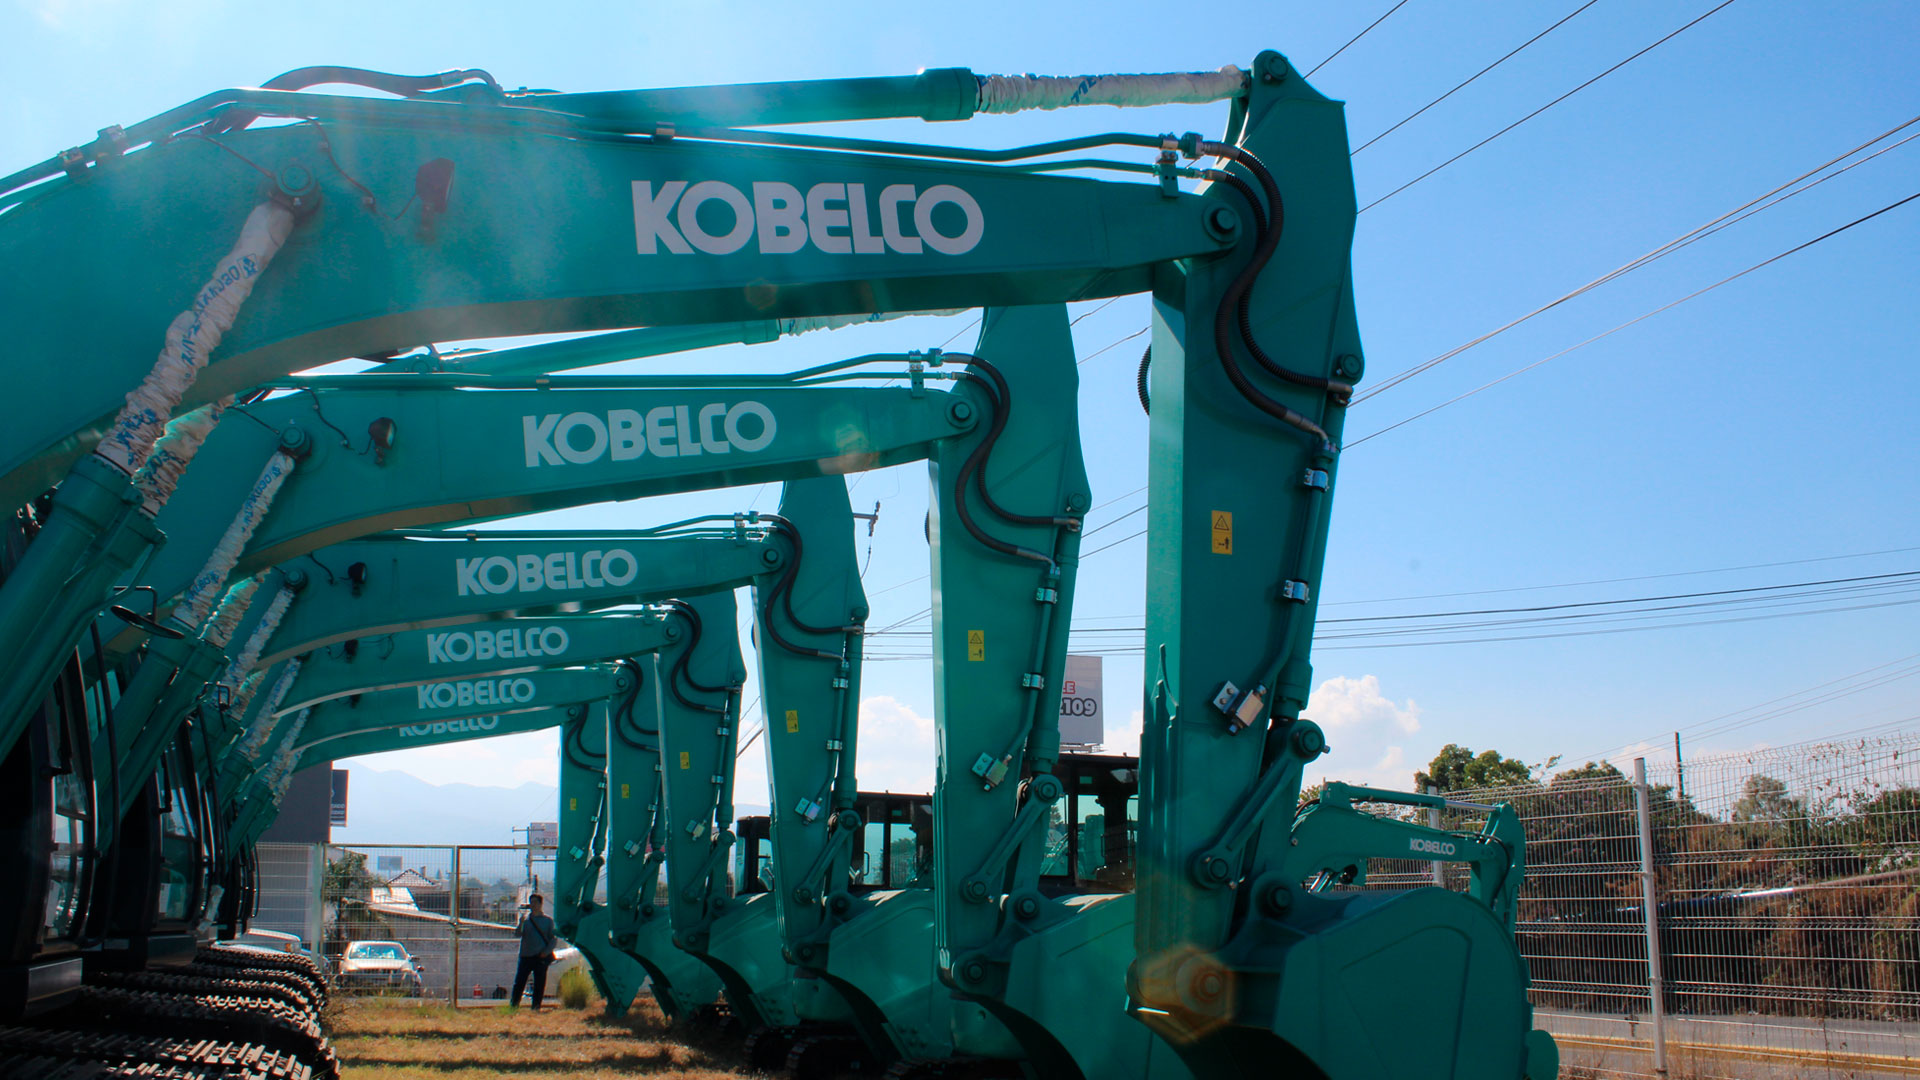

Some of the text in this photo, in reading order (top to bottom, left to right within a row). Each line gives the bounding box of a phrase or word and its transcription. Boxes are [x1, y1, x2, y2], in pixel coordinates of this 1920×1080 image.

[631, 180, 985, 256] KOBELCO
[522, 400, 777, 468] KOBELCO
[456, 548, 638, 597] KOBELCO
[426, 625, 570, 664] KOBELCO
[416, 677, 536, 710] KOBELCO
[1410, 838, 1456, 855] KOBELCO
